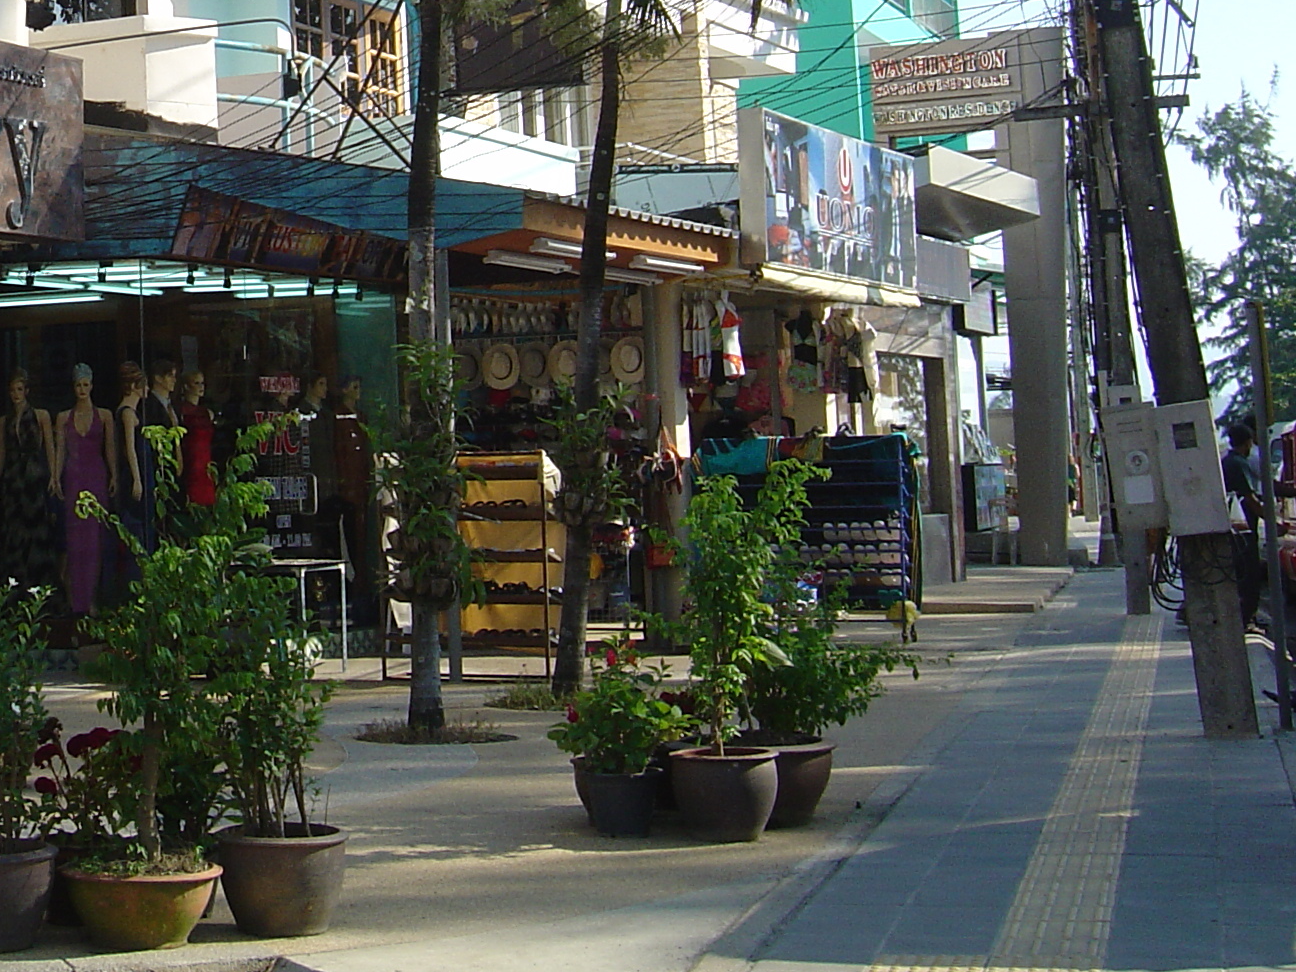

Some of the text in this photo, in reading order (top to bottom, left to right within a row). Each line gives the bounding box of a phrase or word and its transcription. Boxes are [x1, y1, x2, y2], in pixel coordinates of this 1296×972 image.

[871, 48, 1007, 80] WASHINGTON
[873, 100, 1018, 124] WASHINGTON RESIDENCE
[255, 411, 301, 455] VIC
